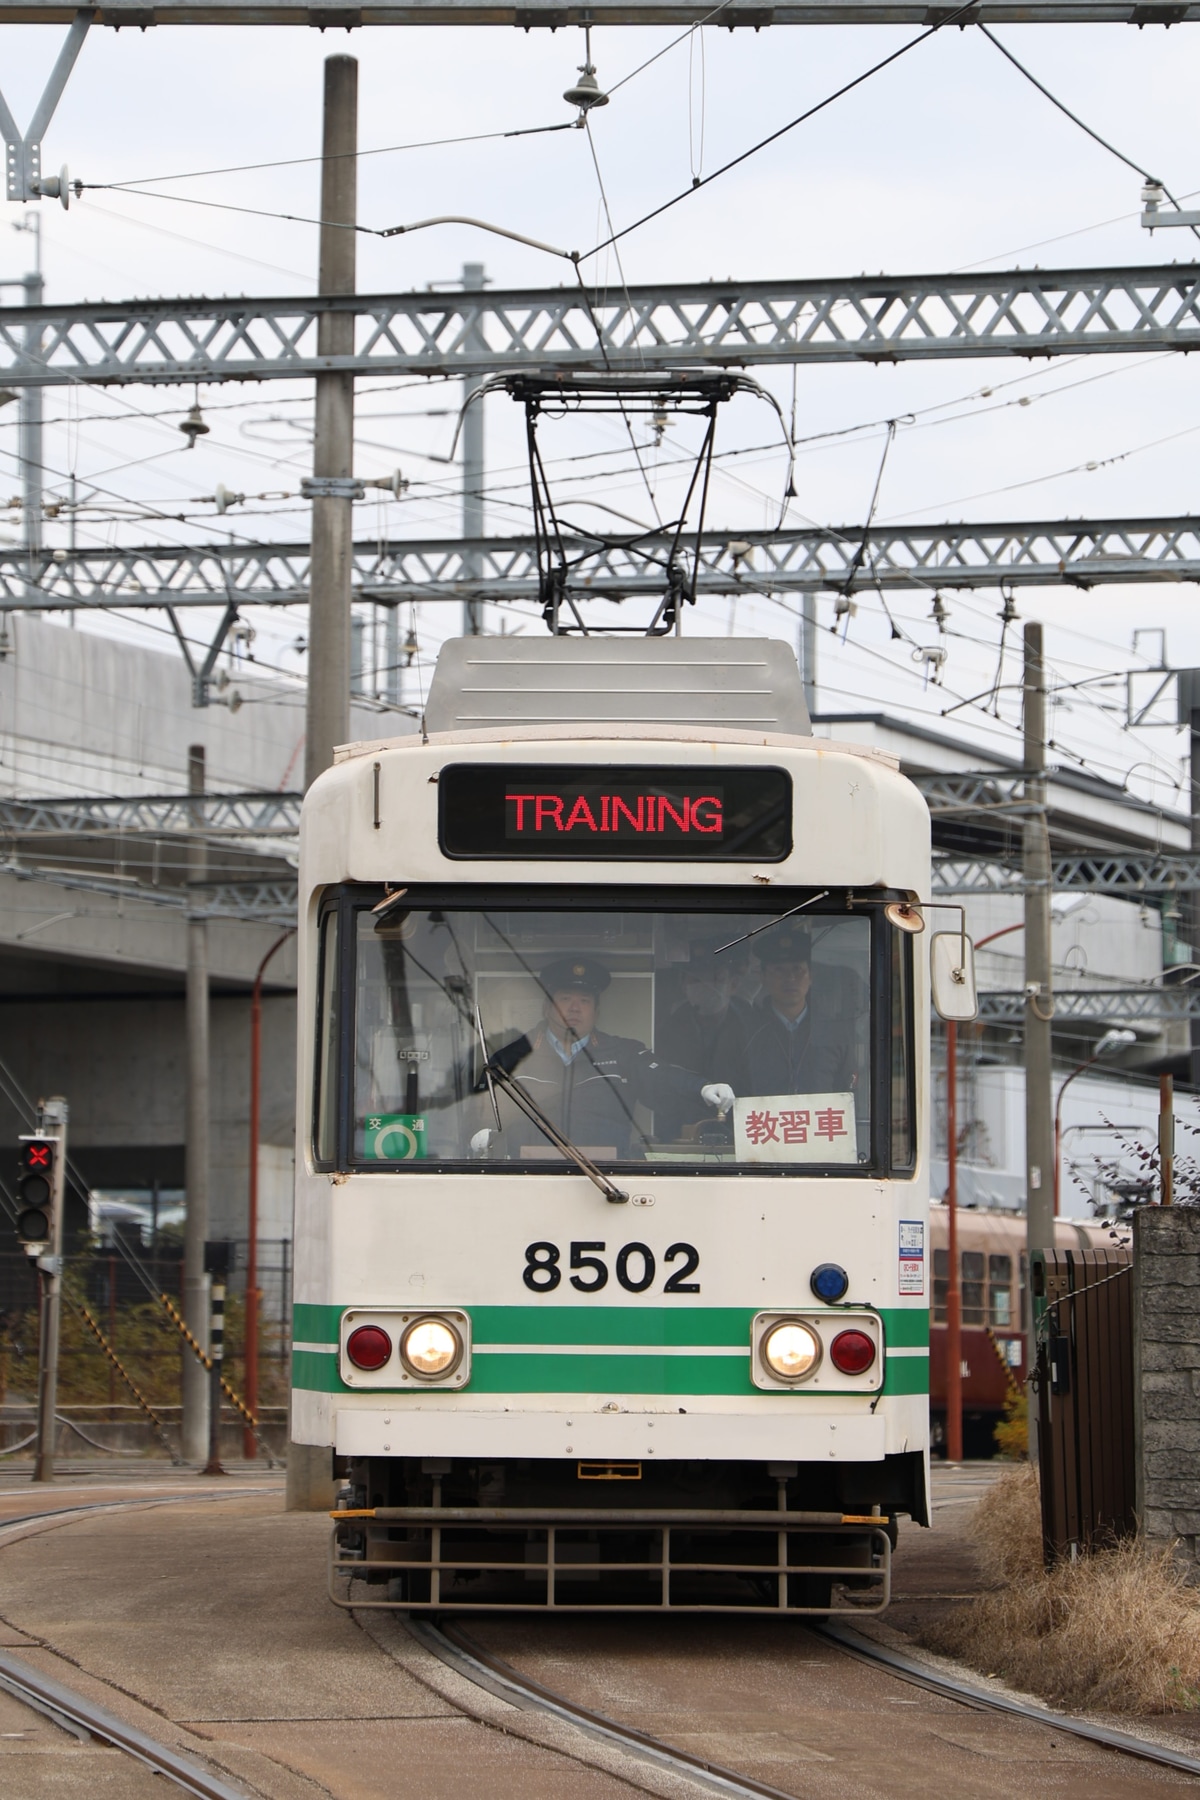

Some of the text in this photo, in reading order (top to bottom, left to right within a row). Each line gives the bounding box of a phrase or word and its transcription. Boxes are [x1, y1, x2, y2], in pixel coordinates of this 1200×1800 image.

[505, 794, 722, 832] TRAINING
[745, 1107, 848, 1145] 教習車
[522, 1241, 701, 1294] 8502
